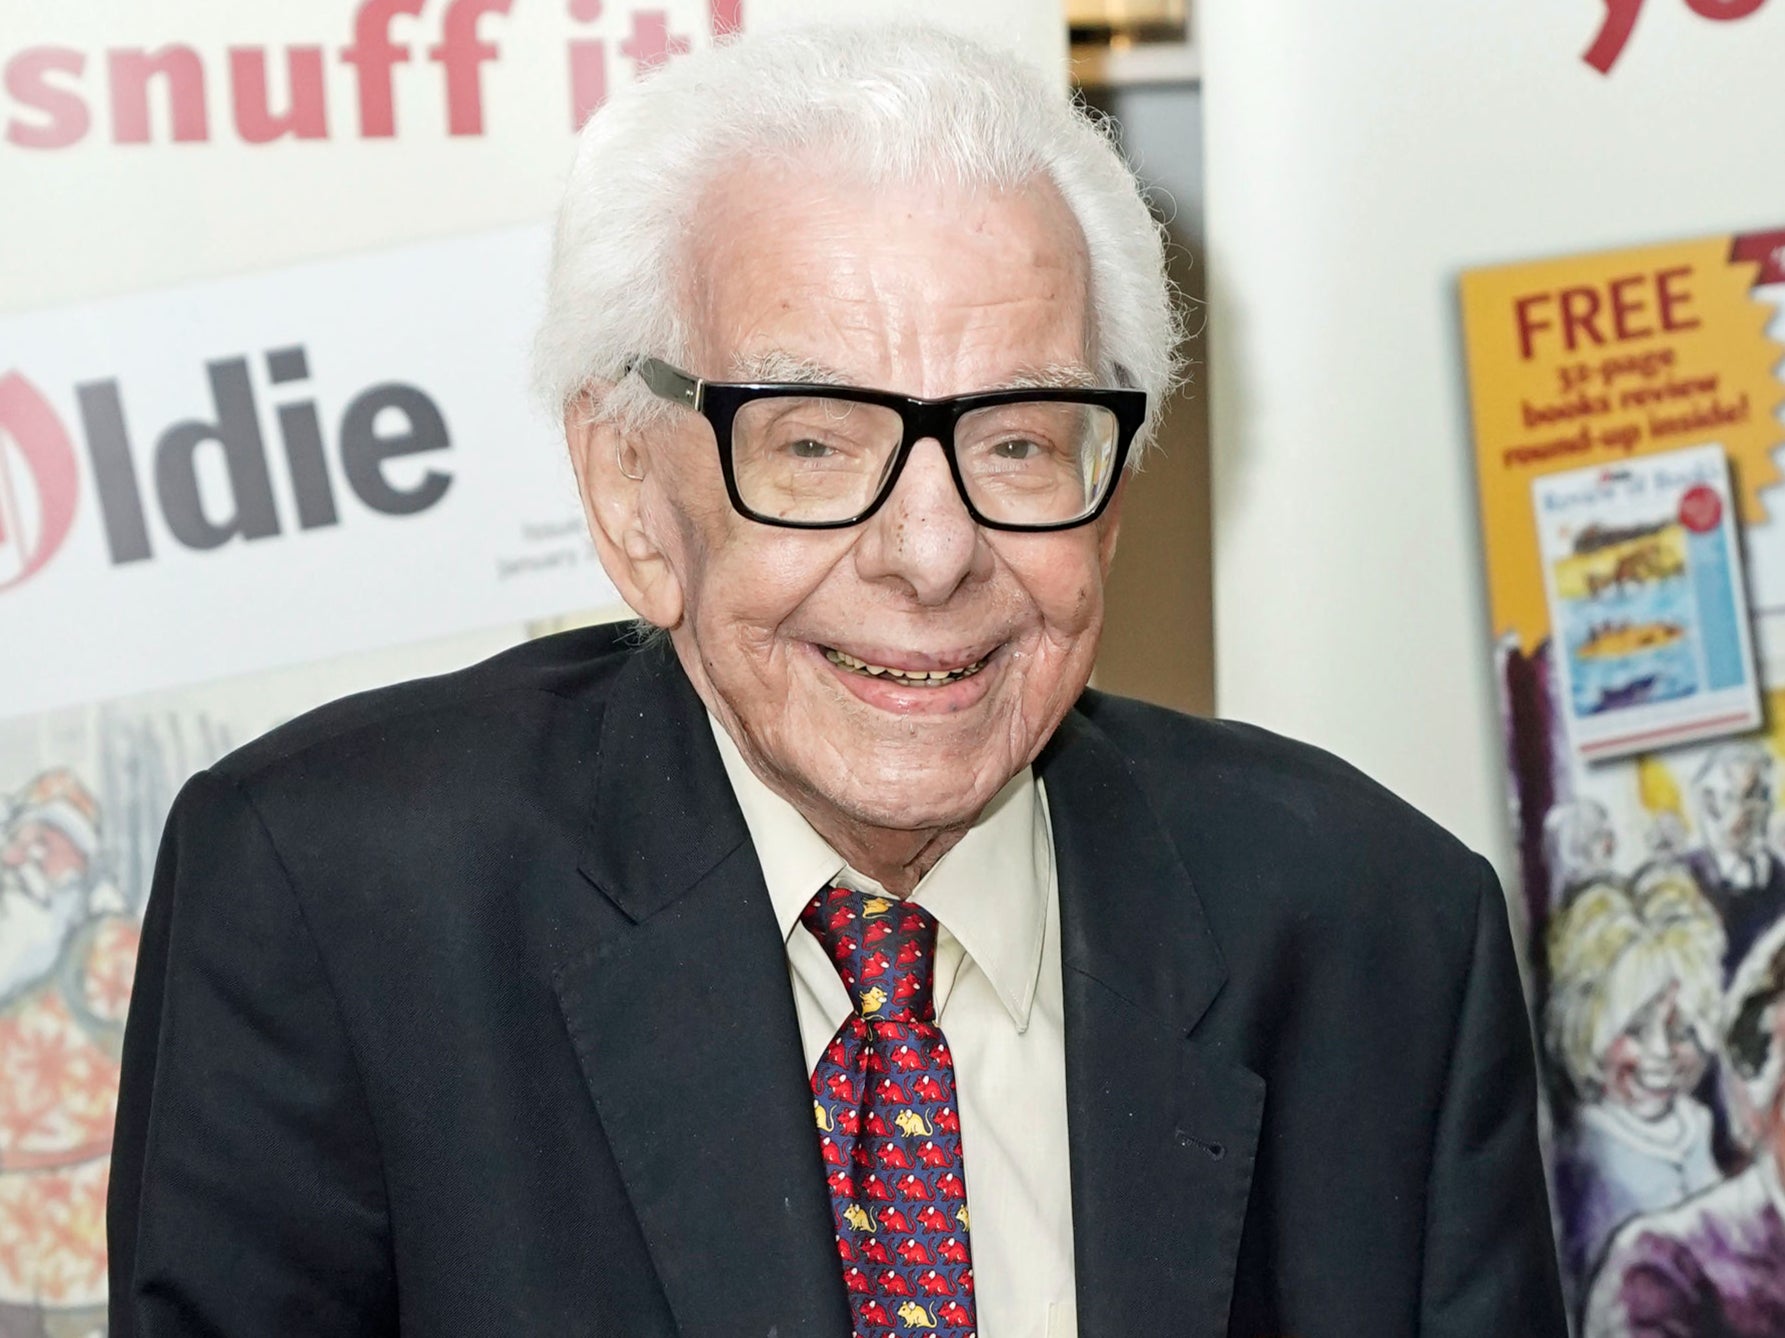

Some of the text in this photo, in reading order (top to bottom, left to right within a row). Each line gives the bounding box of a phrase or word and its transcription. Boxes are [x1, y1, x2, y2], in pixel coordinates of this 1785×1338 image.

[3, 0, 516, 149] snuff
[1513, 264, 1702, 360] FREE
[1502, 394, 1750, 469] round-up inside!
[1520, 374, 1719, 430] books review
